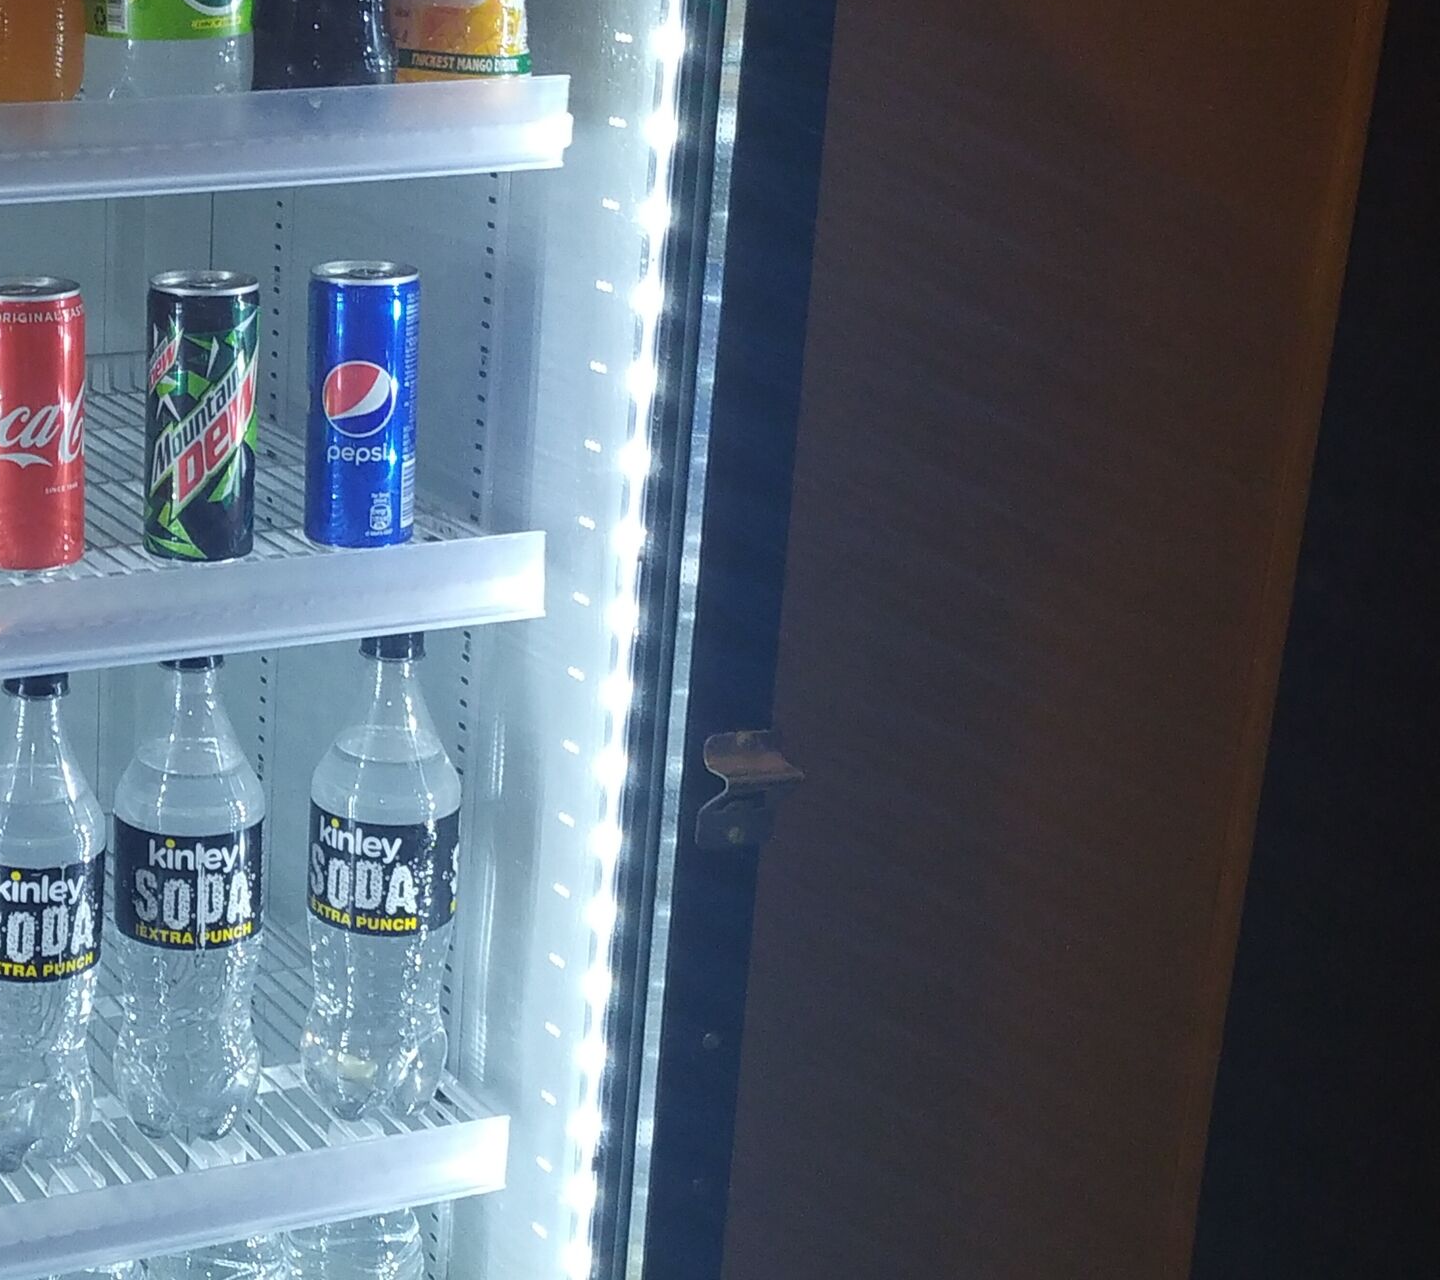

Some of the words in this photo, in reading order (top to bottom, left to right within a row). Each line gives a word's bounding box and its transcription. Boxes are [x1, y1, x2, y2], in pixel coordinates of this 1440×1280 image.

[457, 57, 491, 72] MANGO
[327, 442, 393, 466] pepsi
[320, 815, 402, 864] kinley
[149, 838, 238, 873] kinley
[310, 843, 417, 915] SODA
[134, 868, 253, 930] SODA
[200, 921, 252, 946] PUNCH
[356, 917, 417, 931] PUNCH
[43, 952, 93, 977] PUNCH
